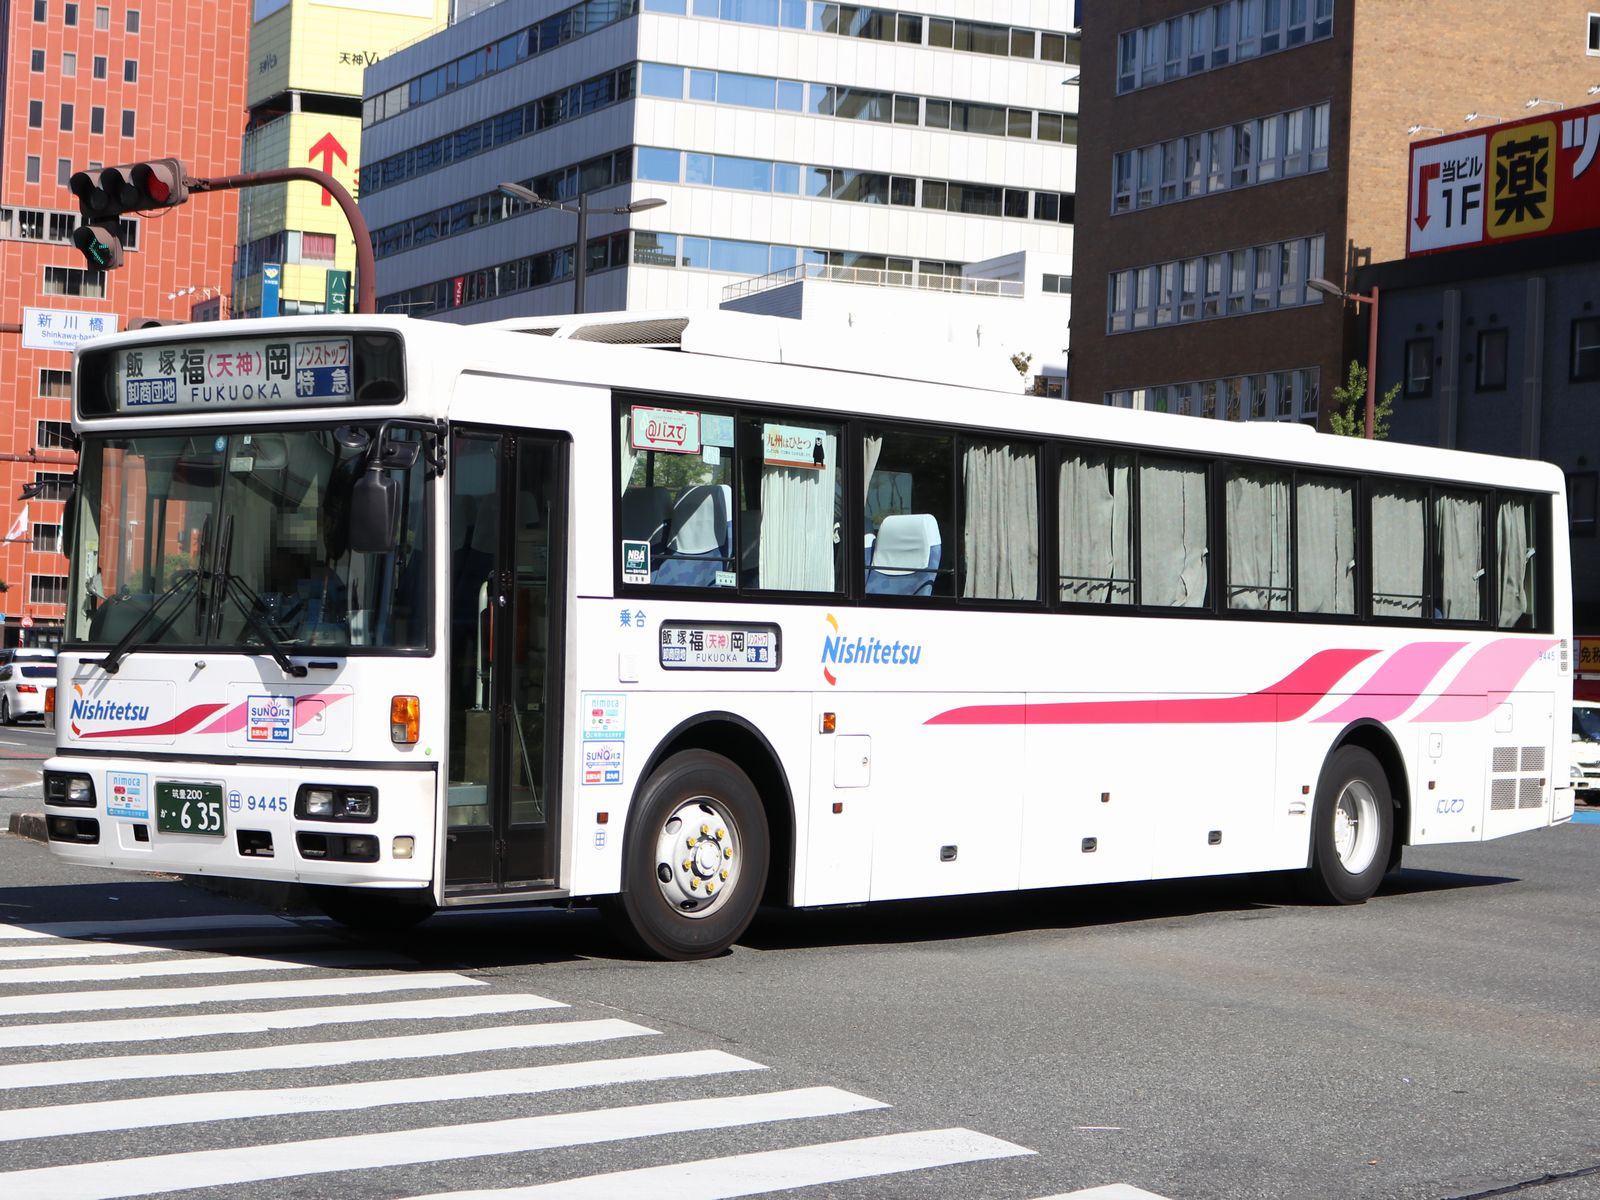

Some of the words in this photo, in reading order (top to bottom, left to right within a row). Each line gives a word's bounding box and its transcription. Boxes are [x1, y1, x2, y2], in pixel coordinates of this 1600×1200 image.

[339, 51, 380, 67] 天神V
[1442, 156, 1483, 183] 当ビル
[1495, 134, 1549, 227] 薬
[1442, 184, 1481, 228] 1F
[331, 277, 347, 314] 八女
[37, 313, 104, 332] 新川橋
[41, 331, 99, 340] Shinkawa-bash
[297, 344, 349, 366] ノンストップ
[125, 351, 177, 379] 飯塚
[296, 368, 350, 396] 特急
[127, 380, 176, 404] 卸商団地
[191, 383, 282, 402] FUKUOKA
[767, 434, 812, 450] 九州はひとつ
[628, 550, 645, 561] NBA
[620, 610, 647, 628] 乗合
[662, 630, 687, 645] 飯塚
[696, 653, 738, 663] FUKUOKA
[747, 647, 768, 662] 特急
[821, 635, 922, 665] Nishitetsu
[70, 699, 150, 721] Nishitetsu
[592, 699, 619, 708] nimoca
[113, 776, 141, 787] nimoca
[247, 796, 288, 812] 9445
